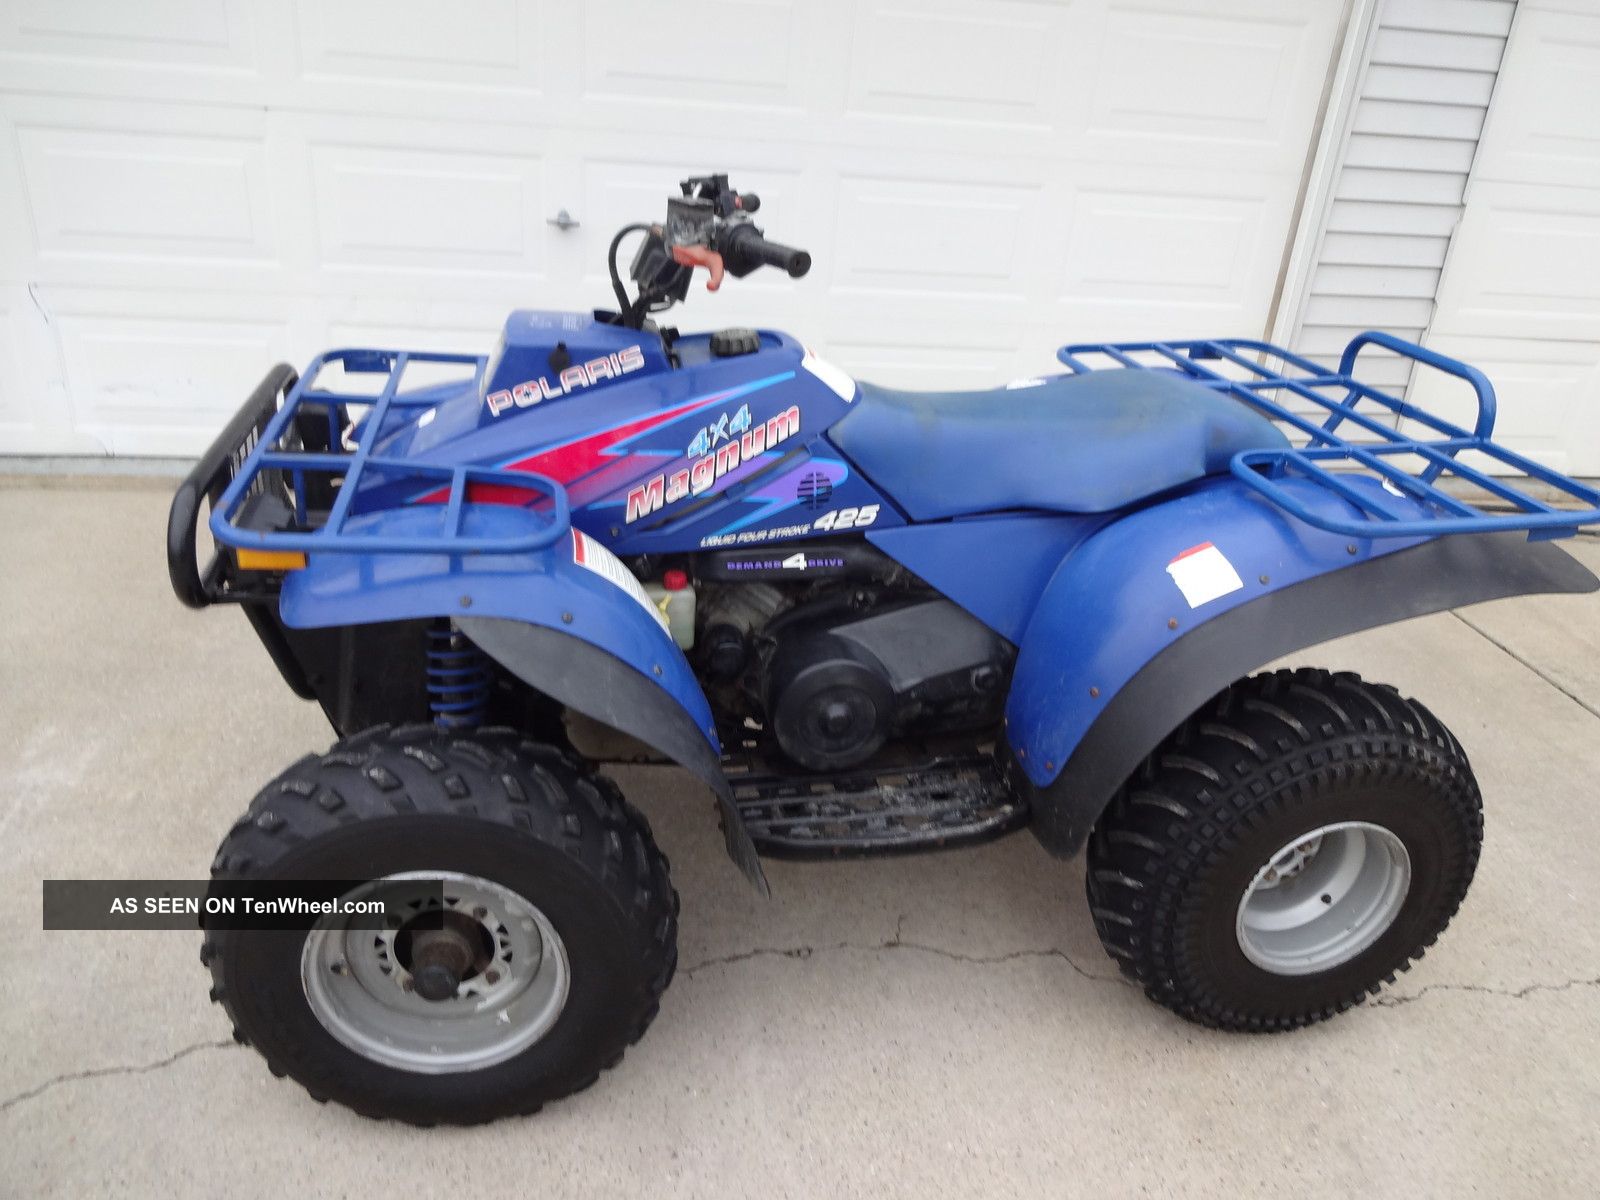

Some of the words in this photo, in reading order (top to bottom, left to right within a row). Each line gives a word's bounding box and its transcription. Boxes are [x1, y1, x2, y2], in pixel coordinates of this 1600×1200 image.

[487, 345, 645, 417] POLARIS
[625, 405, 801, 524] Magnum
[700, 534, 736, 548] LIQUID
[737, 530, 767, 543] FOUR
[768, 523, 811, 539] STROKE
[813, 504, 880, 531] 425
